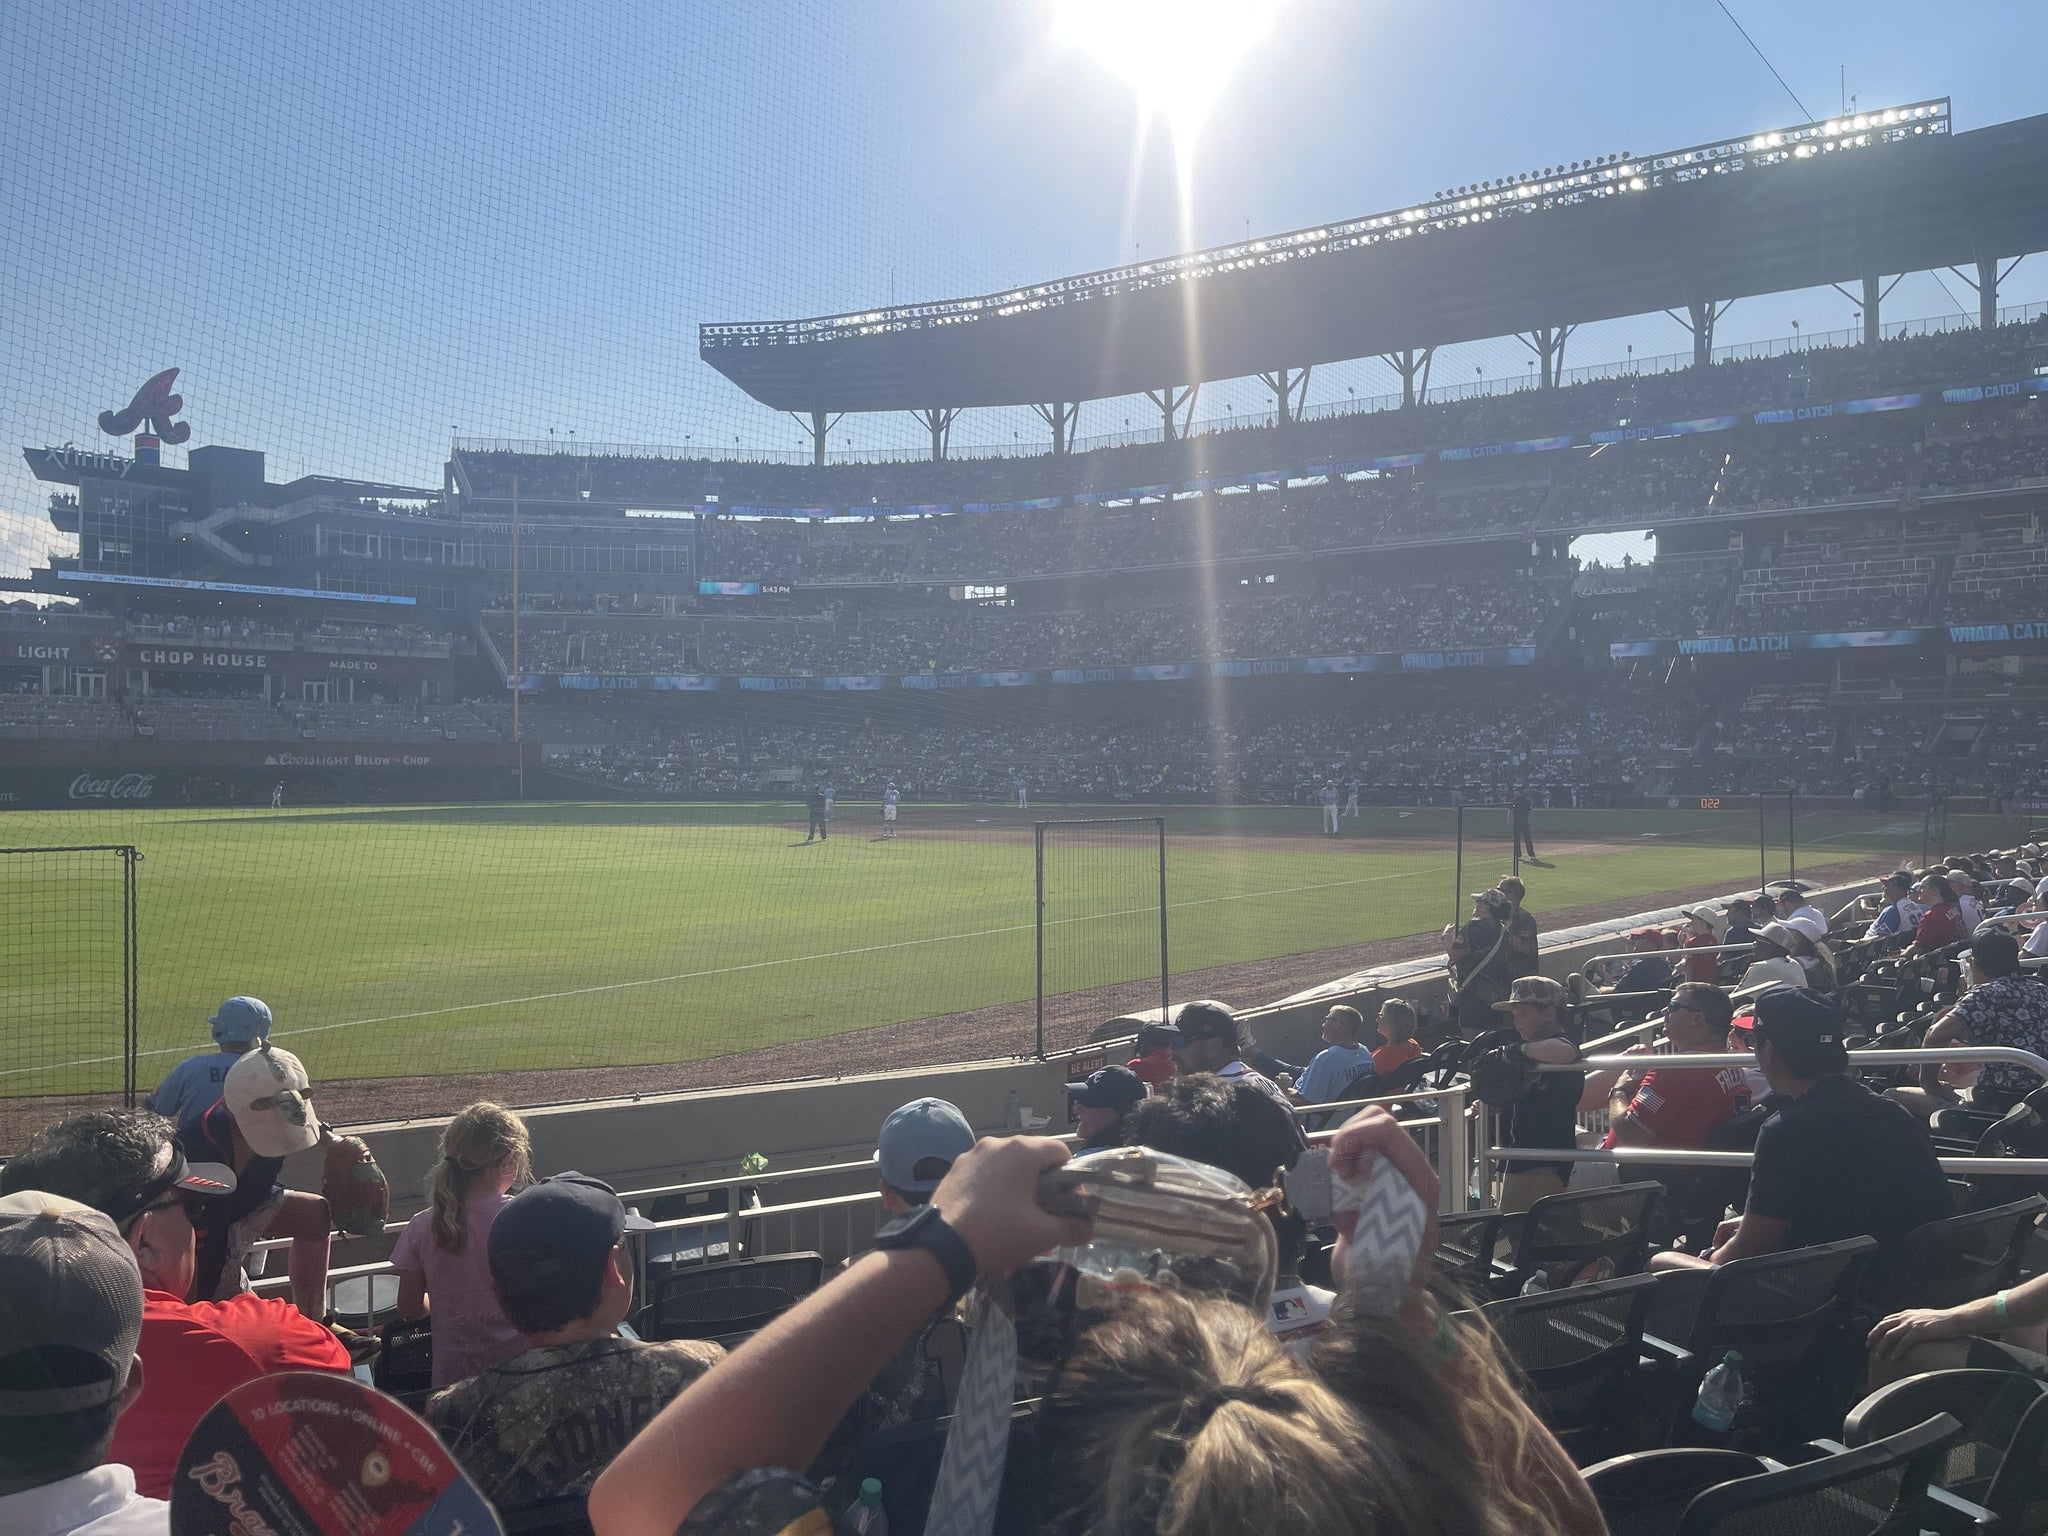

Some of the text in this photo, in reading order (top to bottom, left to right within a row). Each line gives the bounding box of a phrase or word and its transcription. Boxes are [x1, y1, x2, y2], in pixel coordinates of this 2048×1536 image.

[1943, 388, 1974, 403] WHAT
[1985, 382, 2020, 398] CATCH
[1796, 405, 1833, 419] CATCH
[1625, 426, 1655, 439] CATCH
[1473, 445, 1502, 458] CATCH
[45, 441, 135, 478] xfinity
[762, 586, 790, 594] 5:43 PM
[1594, 586, 1638, 595] LEXUS
[1949, 625, 1994, 643] WHAT
[1999, 624, 2010, 640] A
[18, 645, 70, 659] LIGHT
[1677, 636, 1789, 655] WHAT A CATCH
[140, 650, 267, 668] CHOP HOUSE
[329, 661, 361, 670] MADE
[363, 662, 378, 670] TO
[1401, 653, 1434, 669] WHAT
[1446, 651, 1484, 666] CATCH
[1252, 660, 1289, 674] CATCH
[939, 675, 968, 688] CATCH
[1085, 668, 1114, 682] CATCH
[602, 676, 638, 689] CATCH
[777, 677, 806, 690] CATCH
[317, 756, 349, 765] LIGHT
[1701, 798, 1720, 808] 022
[1071, 1058, 1104, 1074] BE ALERT
[250, 1408, 265, 1421] 10
[268, 1399, 340, 1416] LOCATIONS
